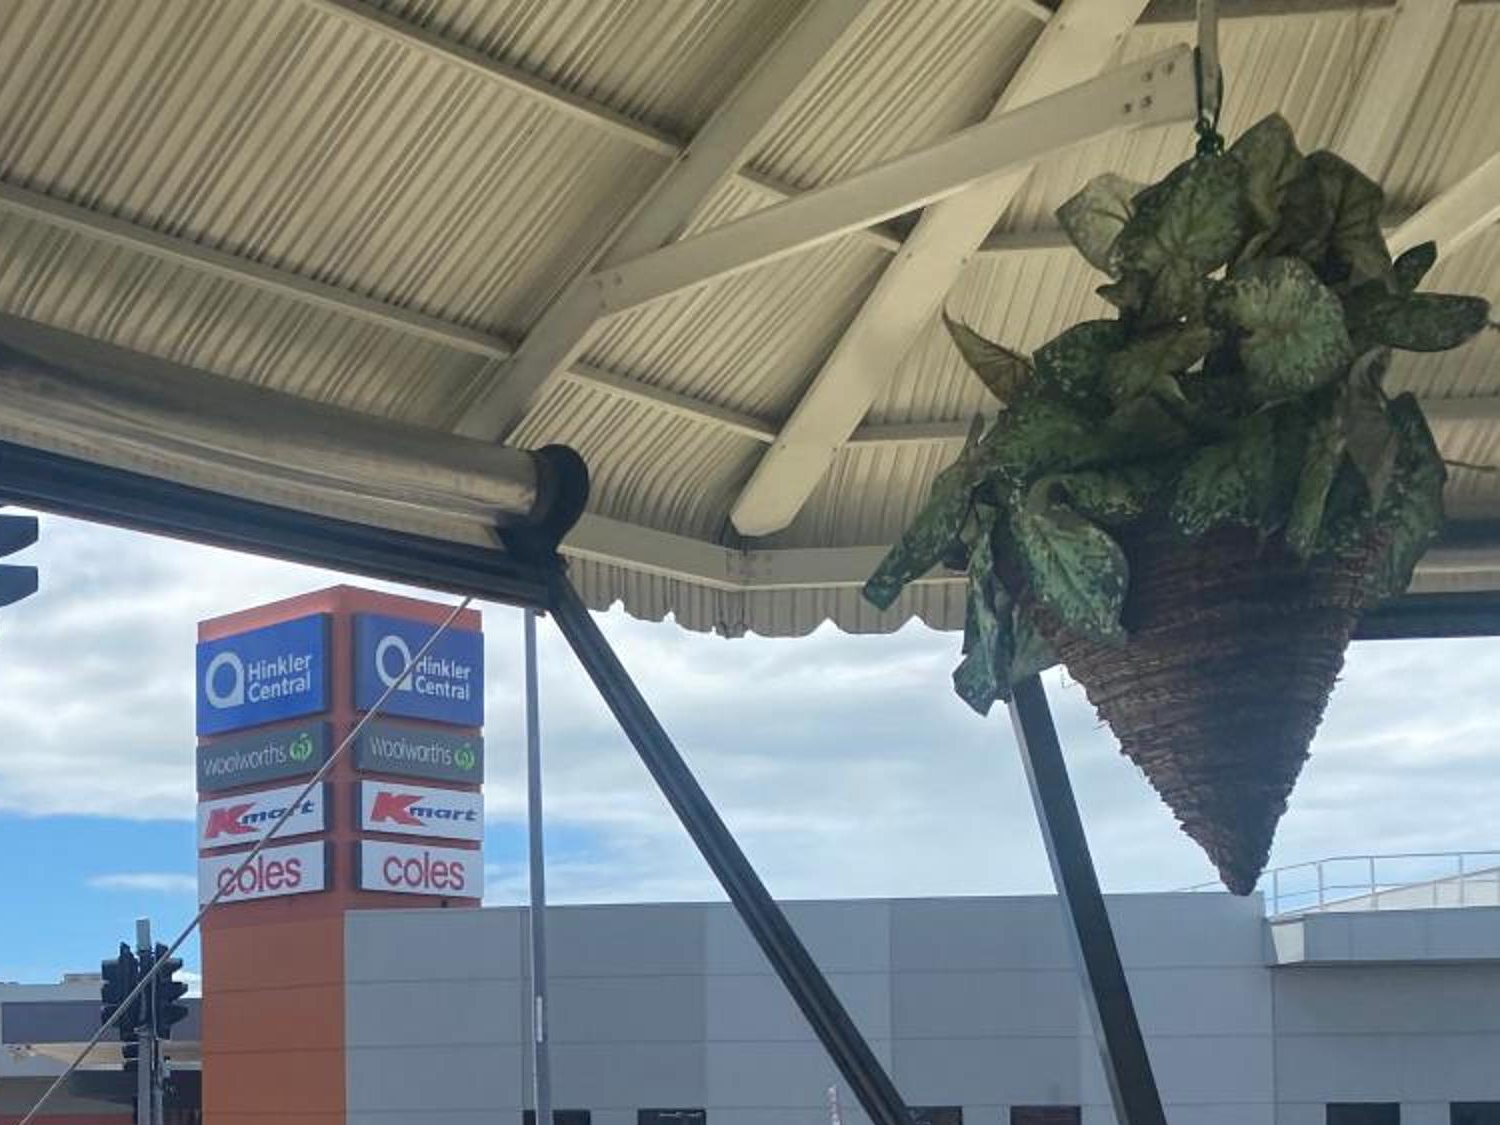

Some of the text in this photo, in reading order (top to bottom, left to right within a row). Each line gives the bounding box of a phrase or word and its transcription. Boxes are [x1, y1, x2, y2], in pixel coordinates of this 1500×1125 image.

[249, 654, 312, 681] Hinkler
[415, 653, 472, 681] Hinkler
[250, 671, 312, 702] Central
[415, 675, 471, 701] Central
[203, 738, 288, 777] Woolworths
[370, 736, 453, 765] Woolworths
[204, 799, 316, 839] Kmart
[370, 791, 478, 827] Kmart
[217, 856, 302, 896] coles
[383, 852, 465, 890] coles
